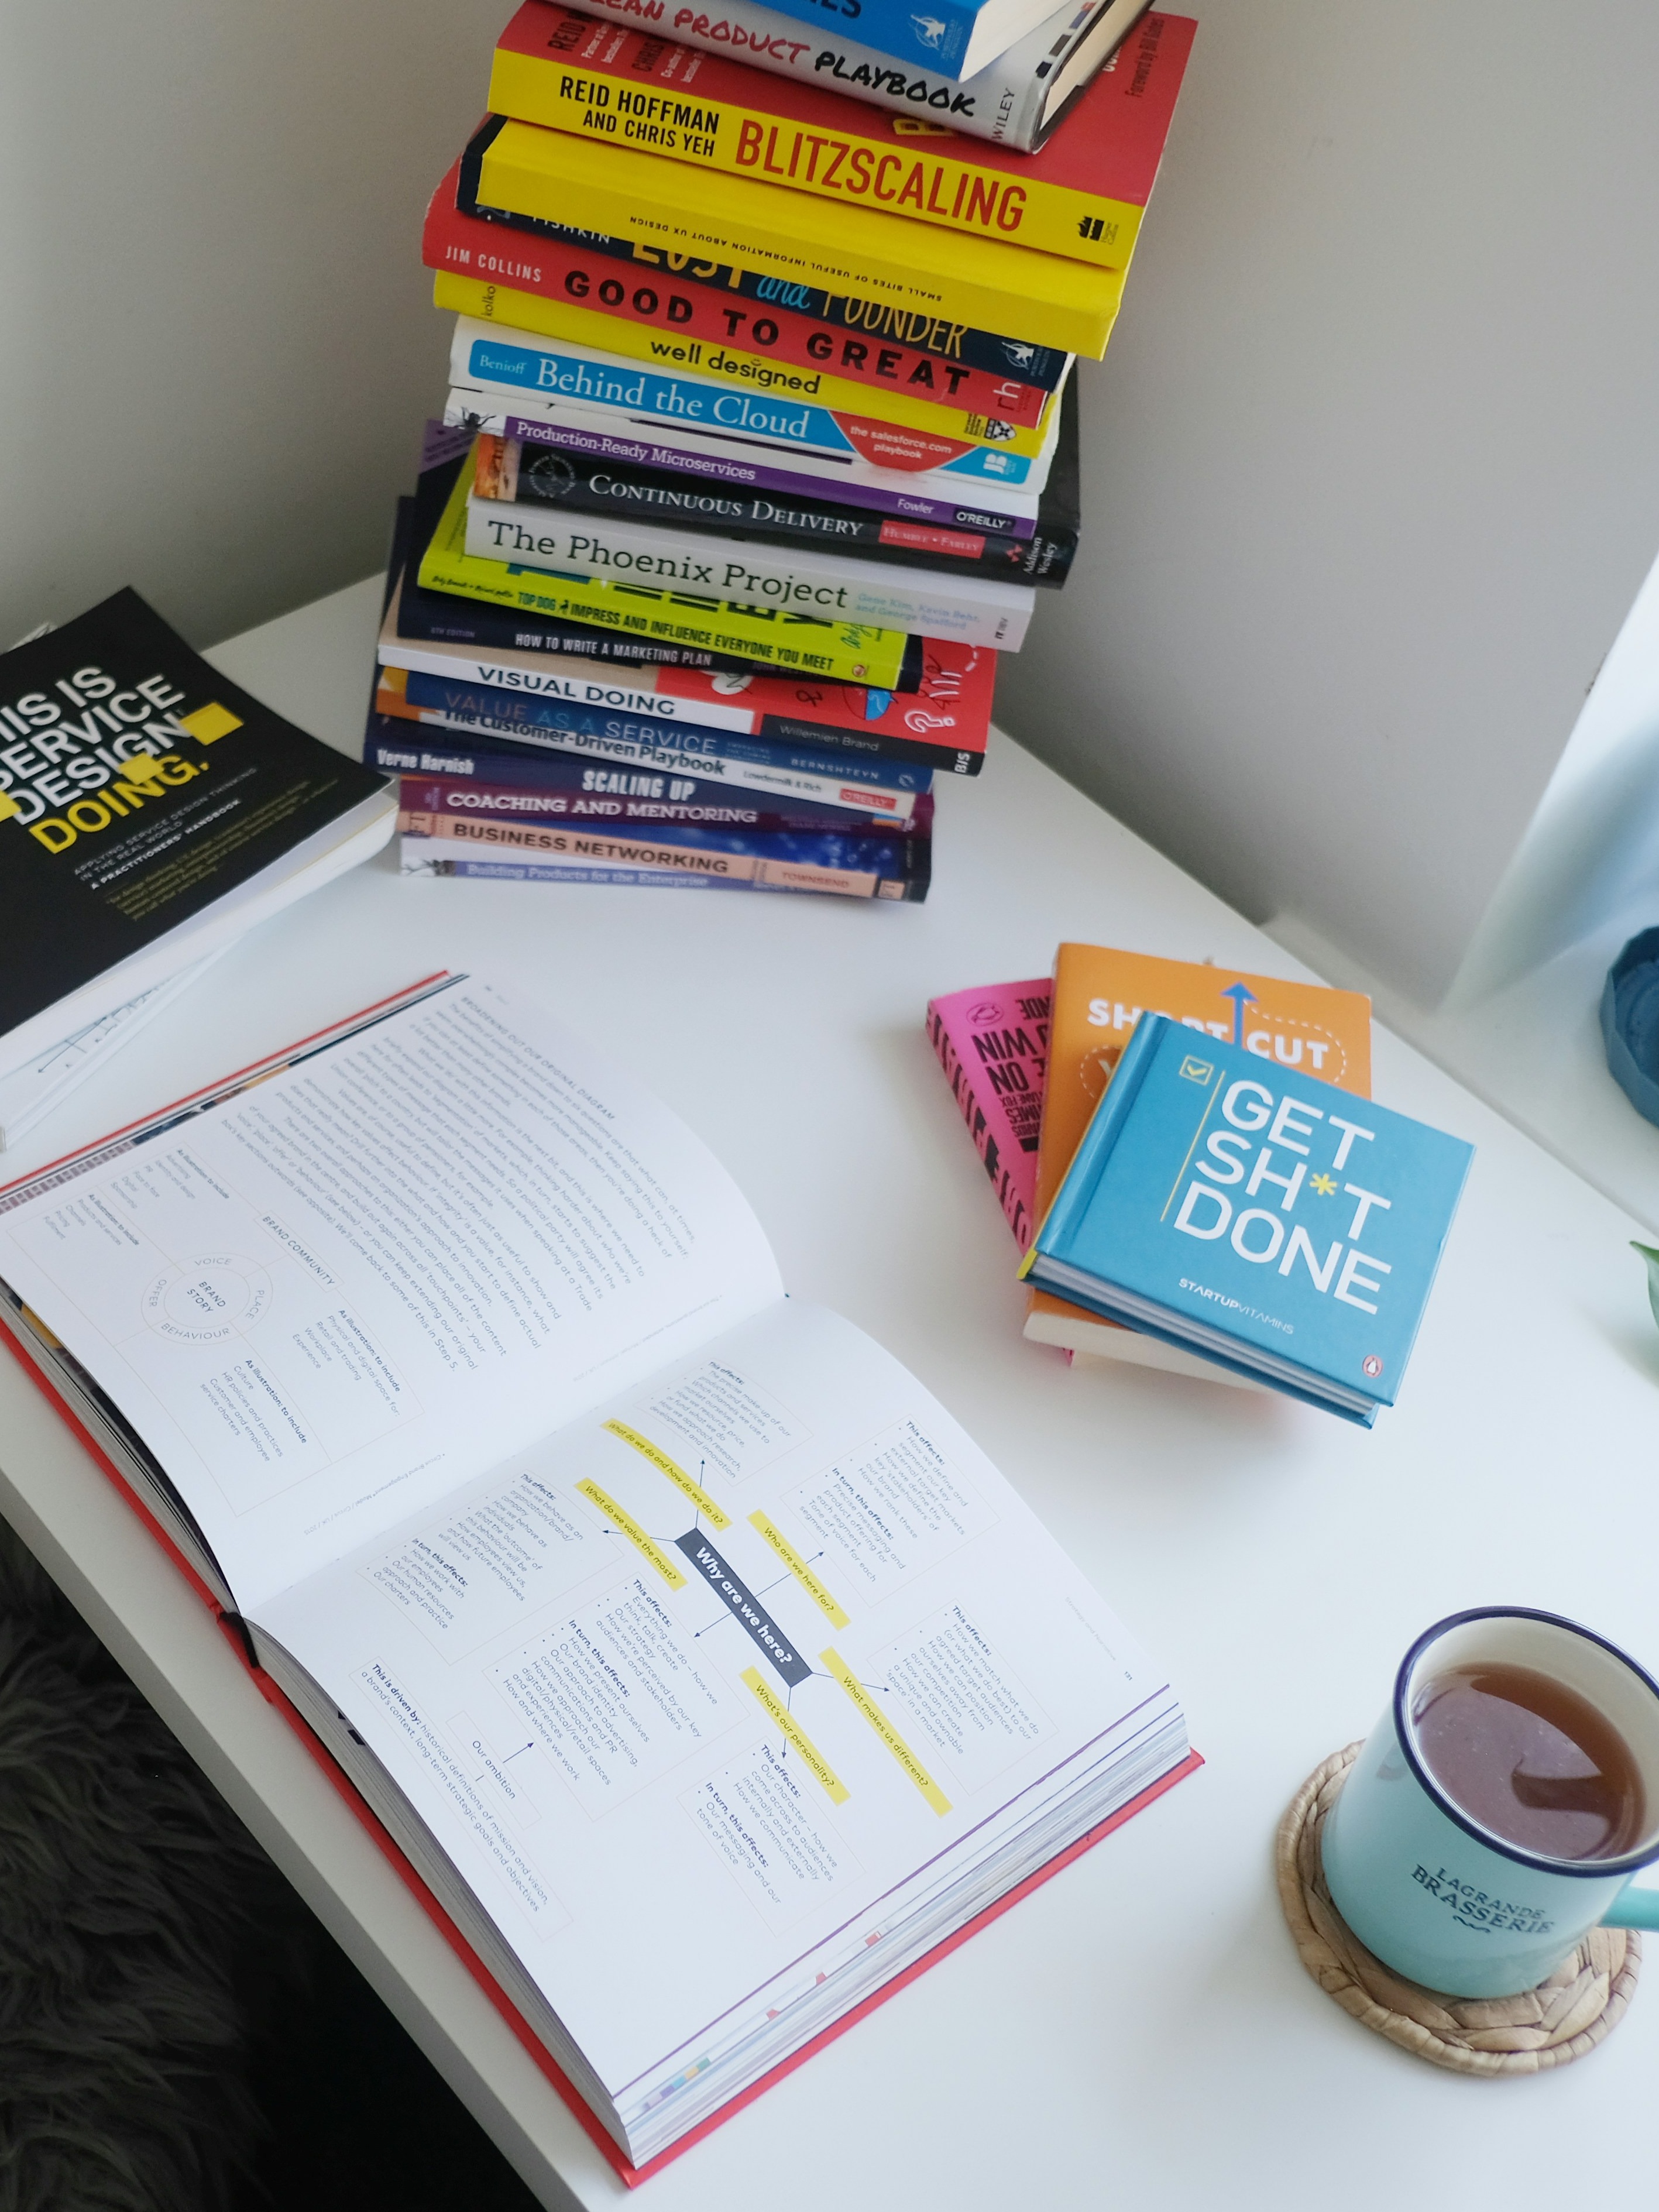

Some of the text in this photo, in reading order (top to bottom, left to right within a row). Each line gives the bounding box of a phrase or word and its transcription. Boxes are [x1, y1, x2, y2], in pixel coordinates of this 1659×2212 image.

[674, 8, 810, 64] PRODUCT
[815, 51, 976, 117] PLAYBOOK
[559, 76, 720, 135] REID HOFFMAN
[991, 87, 1016, 140] WILEY
[582, 109, 715, 157] AND CHRIS YEH
[735, 119, 1027, 232] BLITZSCALING
[446, 246, 542, 283] JIM COLLINS
[630, 216, 942, 301] SMALL BITES OF USEFUL INFORMATION ABOUT UX DESIGN
[481, 286, 496, 317] kolko
[565, 270, 693, 323] GOOD
[723, 308, 779, 346] TO
[806, 333, 970, 396] GREAT
[479, 355, 527, 375] Benioff
[651, 341, 821, 395] well designed
[536, 358, 810, 439] Behind the Cloud
[517, 422, 756, 482] Production-Ready Microservices
[850, 426, 952, 455] the salesforce.com
[874, 443, 922, 460] playbook
[589, 475, 743, 518] CONTINUOUS
[752, 500, 864, 535] DELIVERY
[898, 498, 934, 515] Fowler
[488, 520, 555, 555] The
[567, 536, 713, 583] Phoenix
[722, 564, 847, 609] Project
[515, 633, 712, 666] HOW TO WRITE A MARKETING PLAN
[518, 592, 537, 606] TOP
[537, 596, 557, 611] DOG
[571, 603, 621, 625] IMPRESS
[623, 615, 647, 631] AND
[650, 620, 712, 644] INFLUENCE
[715, 634, 773, 658] EVERYONE
[777, 647, 799, 664] YOU
[802, 653, 834, 671] MEET
[55, 667, 116, 707] IS
[477, 666, 675, 715] VISUAL DOING
[444, 710, 476, 725] The
[480, 715, 635, 757] Customer-Driven
[640, 746, 725, 777] Playbook
[445, 691, 527, 720] VALUE
[536, 710, 569, 729] AS
[578, 717, 596, 733] A
[605, 721, 717, 755] SERVICE
[779, 724, 879, 751] Willemien Brand
[377, 748, 474, 775] Verne Harnish
[582, 770, 695, 802] SCALING UP
[791, 758, 878, 779] BERNSHTEYN
[954, 751, 971, 774] BIS
[29, 754, 209, 854] DOING.
[446, 792, 568, 813] COACHING
[573, 801, 621, 816] AND
[626, 803, 758, 823] MENTORING
[454, 823, 729, 873] BUSINESS NETWORKING
[1246, 1031, 1328, 1070] CUT
[1221, 1079, 1375, 1170] GET
[194, 1258, 233, 1266] VOICE
[263, 1216, 335, 1286] BRAND COMMUNITY
[1173, 1181, 1392, 1315] DONE
[149, 1279, 167, 1307] OFFER
[187, 1288, 214, 1313] STORY
[198, 1281, 226, 1308] BRAND
[245, 1289, 265, 1320] PLACE
[161, 1323, 230, 1340] BEHAVIOUR
[304, 1327, 333, 1363] Workplace
[233, 1365, 254, 1390] Culture
[634, 1440, 645, 1449] we
[645, 1447, 654, 1457] do
[654, 1457, 669, 1469] and
[667, 1468, 682, 1482] how
[682, 1482, 692, 1492] do
[692, 1492, 702, 1503] we
[702, 1502, 712, 1513] do
[711, 1513, 723, 1523] it?
[586, 1486, 677, 1580] What do we value the most?
[764, 1527, 834, 1611] Who are we here for?
[632, 1579, 673, 1629] This affects:
[696, 1547, 792, 1663] Why are we here?
[952, 1605, 992, 1657] This affects:
[372, 1664, 422, 1725] This is driven by:
[503, 1678, 581, 1782] How and where we work
[756, 1684, 834, 1787] What's our personality?
[843, 1676, 929, 1787] What makes us different?
[472, 1740, 516, 1800] Our ambition
[1411, 1863, 1555, 1933] BRASSERIE
